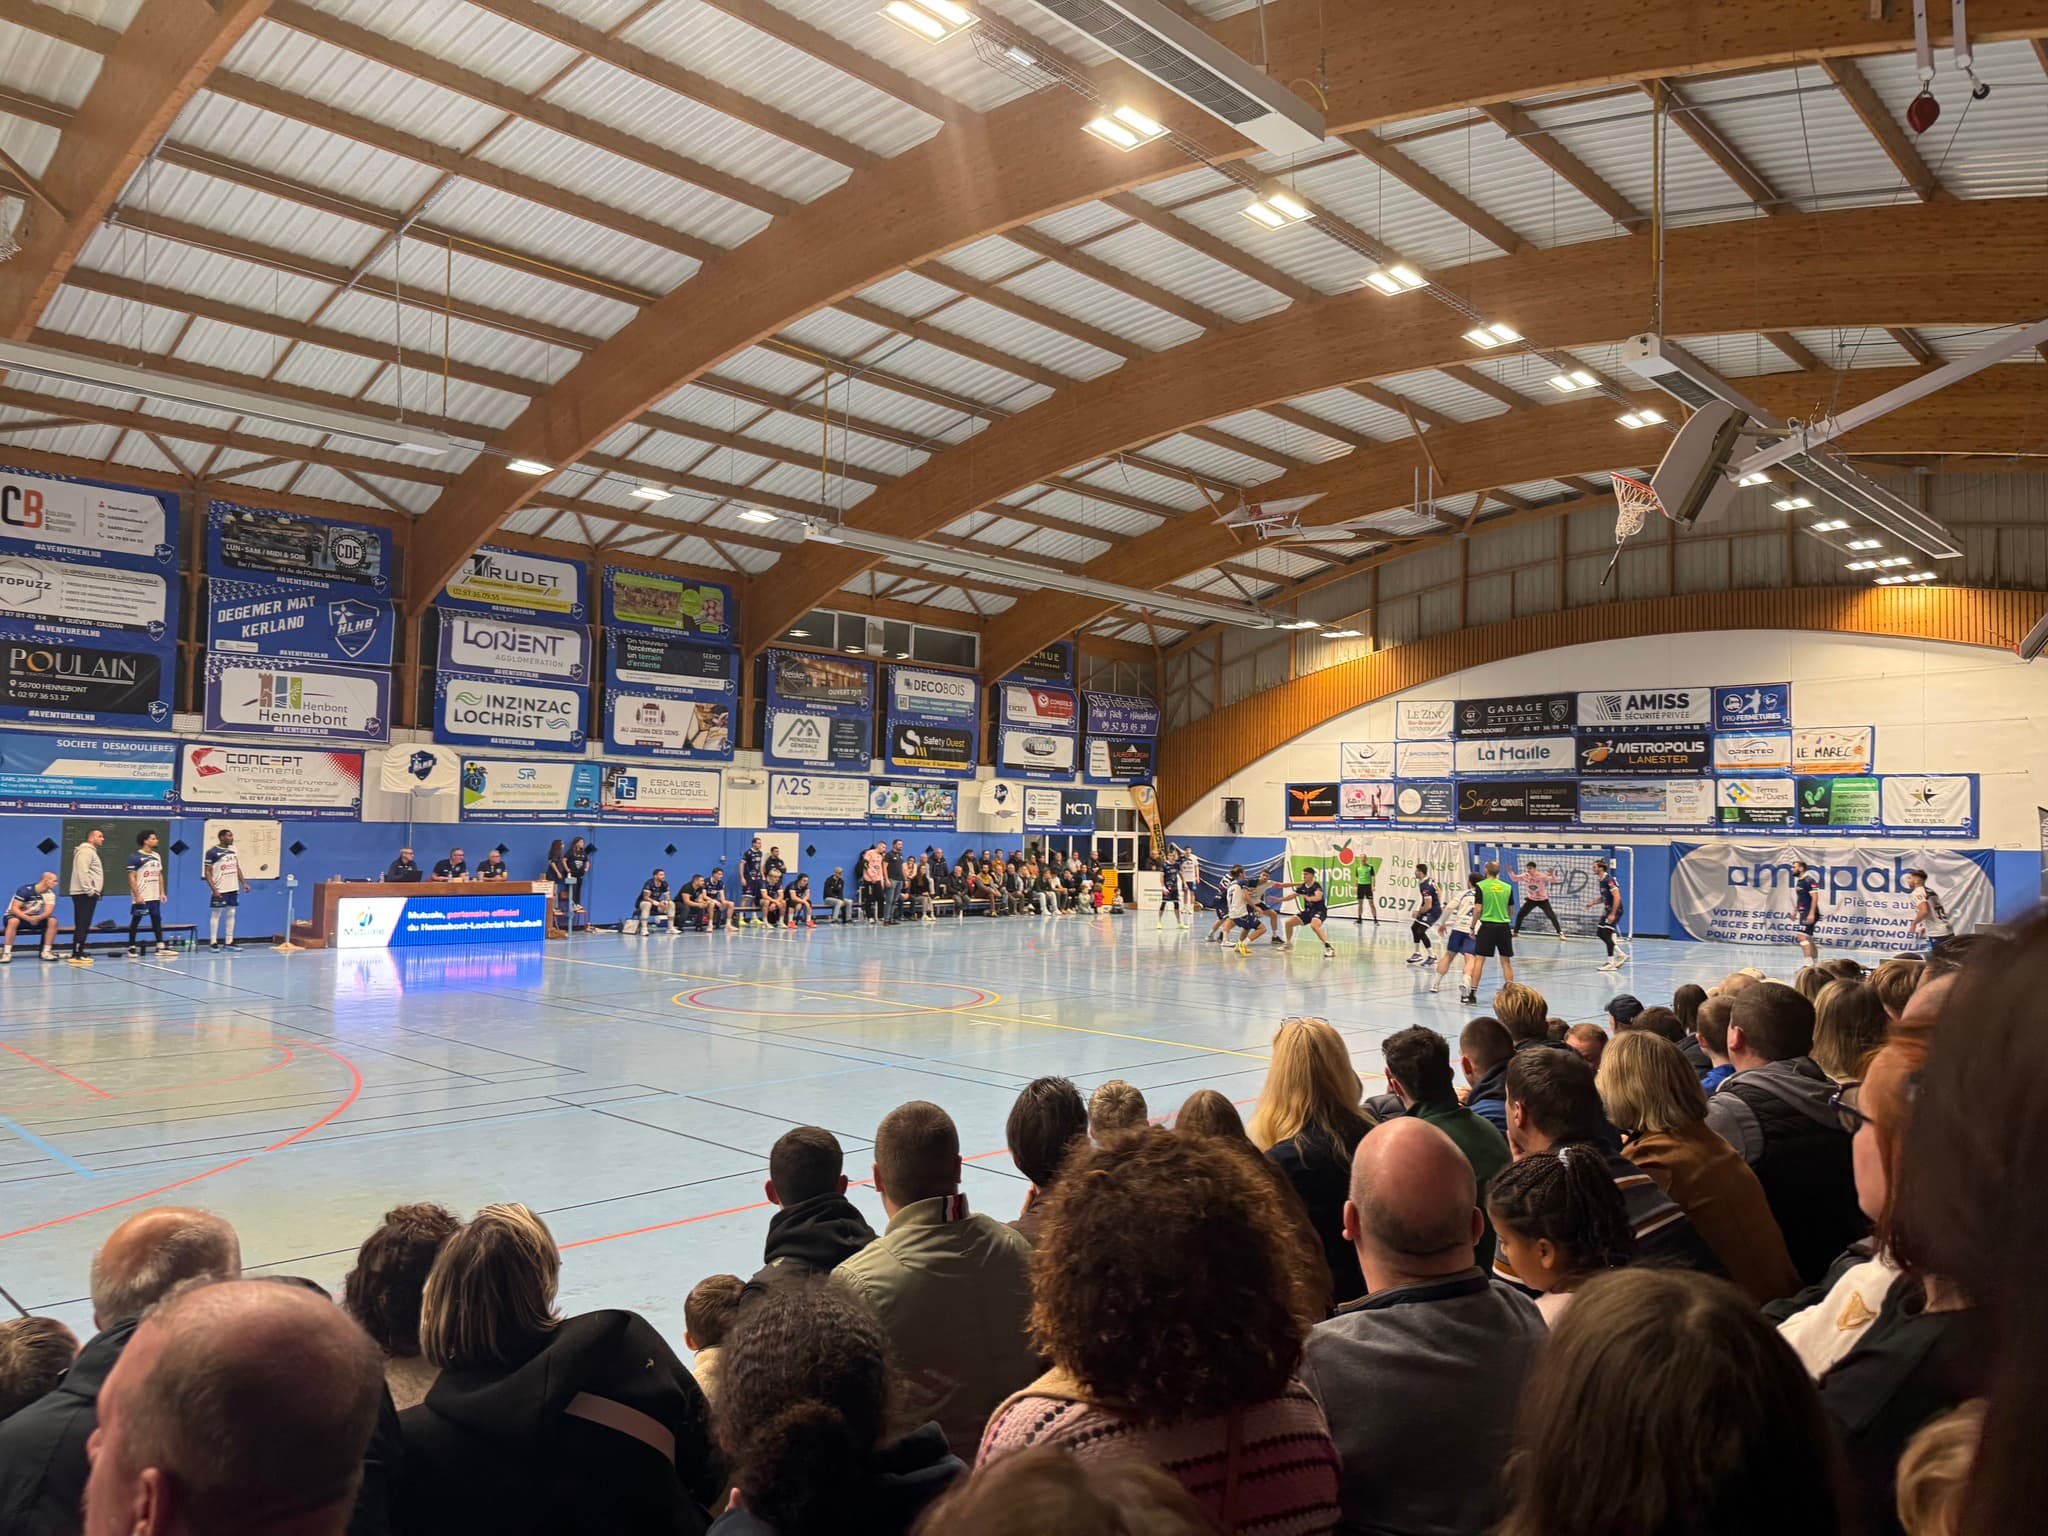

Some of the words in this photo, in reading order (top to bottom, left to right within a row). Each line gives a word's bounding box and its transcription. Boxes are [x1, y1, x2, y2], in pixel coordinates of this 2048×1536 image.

[2, 485, 43, 528] CB
[337, 544, 360, 560] CDE
[218, 600, 282, 623] DEGEMER
[286, 596, 315, 611] MAT
[338, 618, 373, 635] HLHB
[10, 648, 136, 680] POULAIN
[42, 683, 88, 693] HENNEBONT
[914, 680, 965, 696] DECOBOIS
[303, 701, 348, 713] Henbont
[487, 694, 571, 714] INZINZAC
[1626, 693, 1689, 710] AMISS
[1488, 703, 1543, 714] GARAGE
[259, 709, 348, 727] Hennebont
[56, 740, 97, 749] SOCIETE
[102, 742, 175, 752] DESMOULIERES
[923, 736, 945, 747] Safety
[1615, 742, 1705, 753] METROPOLIS
[1478, 747, 1495, 760] La
[1500, 746, 1550, 760] Maille
[1797, 747, 1807, 758] LE
[226, 753, 303, 767] CONCEPT
[1629, 755, 1688, 764] LANESTER
[226, 765, 303, 776] imprimerie
[517, 768, 536, 780] SR
[650, 779, 700, 788] ESCALIERS
[1392, 855, 1413, 868] Rue
[1892, 902, 1915, 910] aut
[1713, 908, 1750, 918] VOTRE
[1751, 911, 1824, 921] SPECIAE
[407, 923, 419, 931] du
[506, 919, 542, 928] Handball
[1710, 920, 1749, 928] PIECES
[1706, 930, 1736, 940] POUR
[1835, 938, 1850, 947] ET
